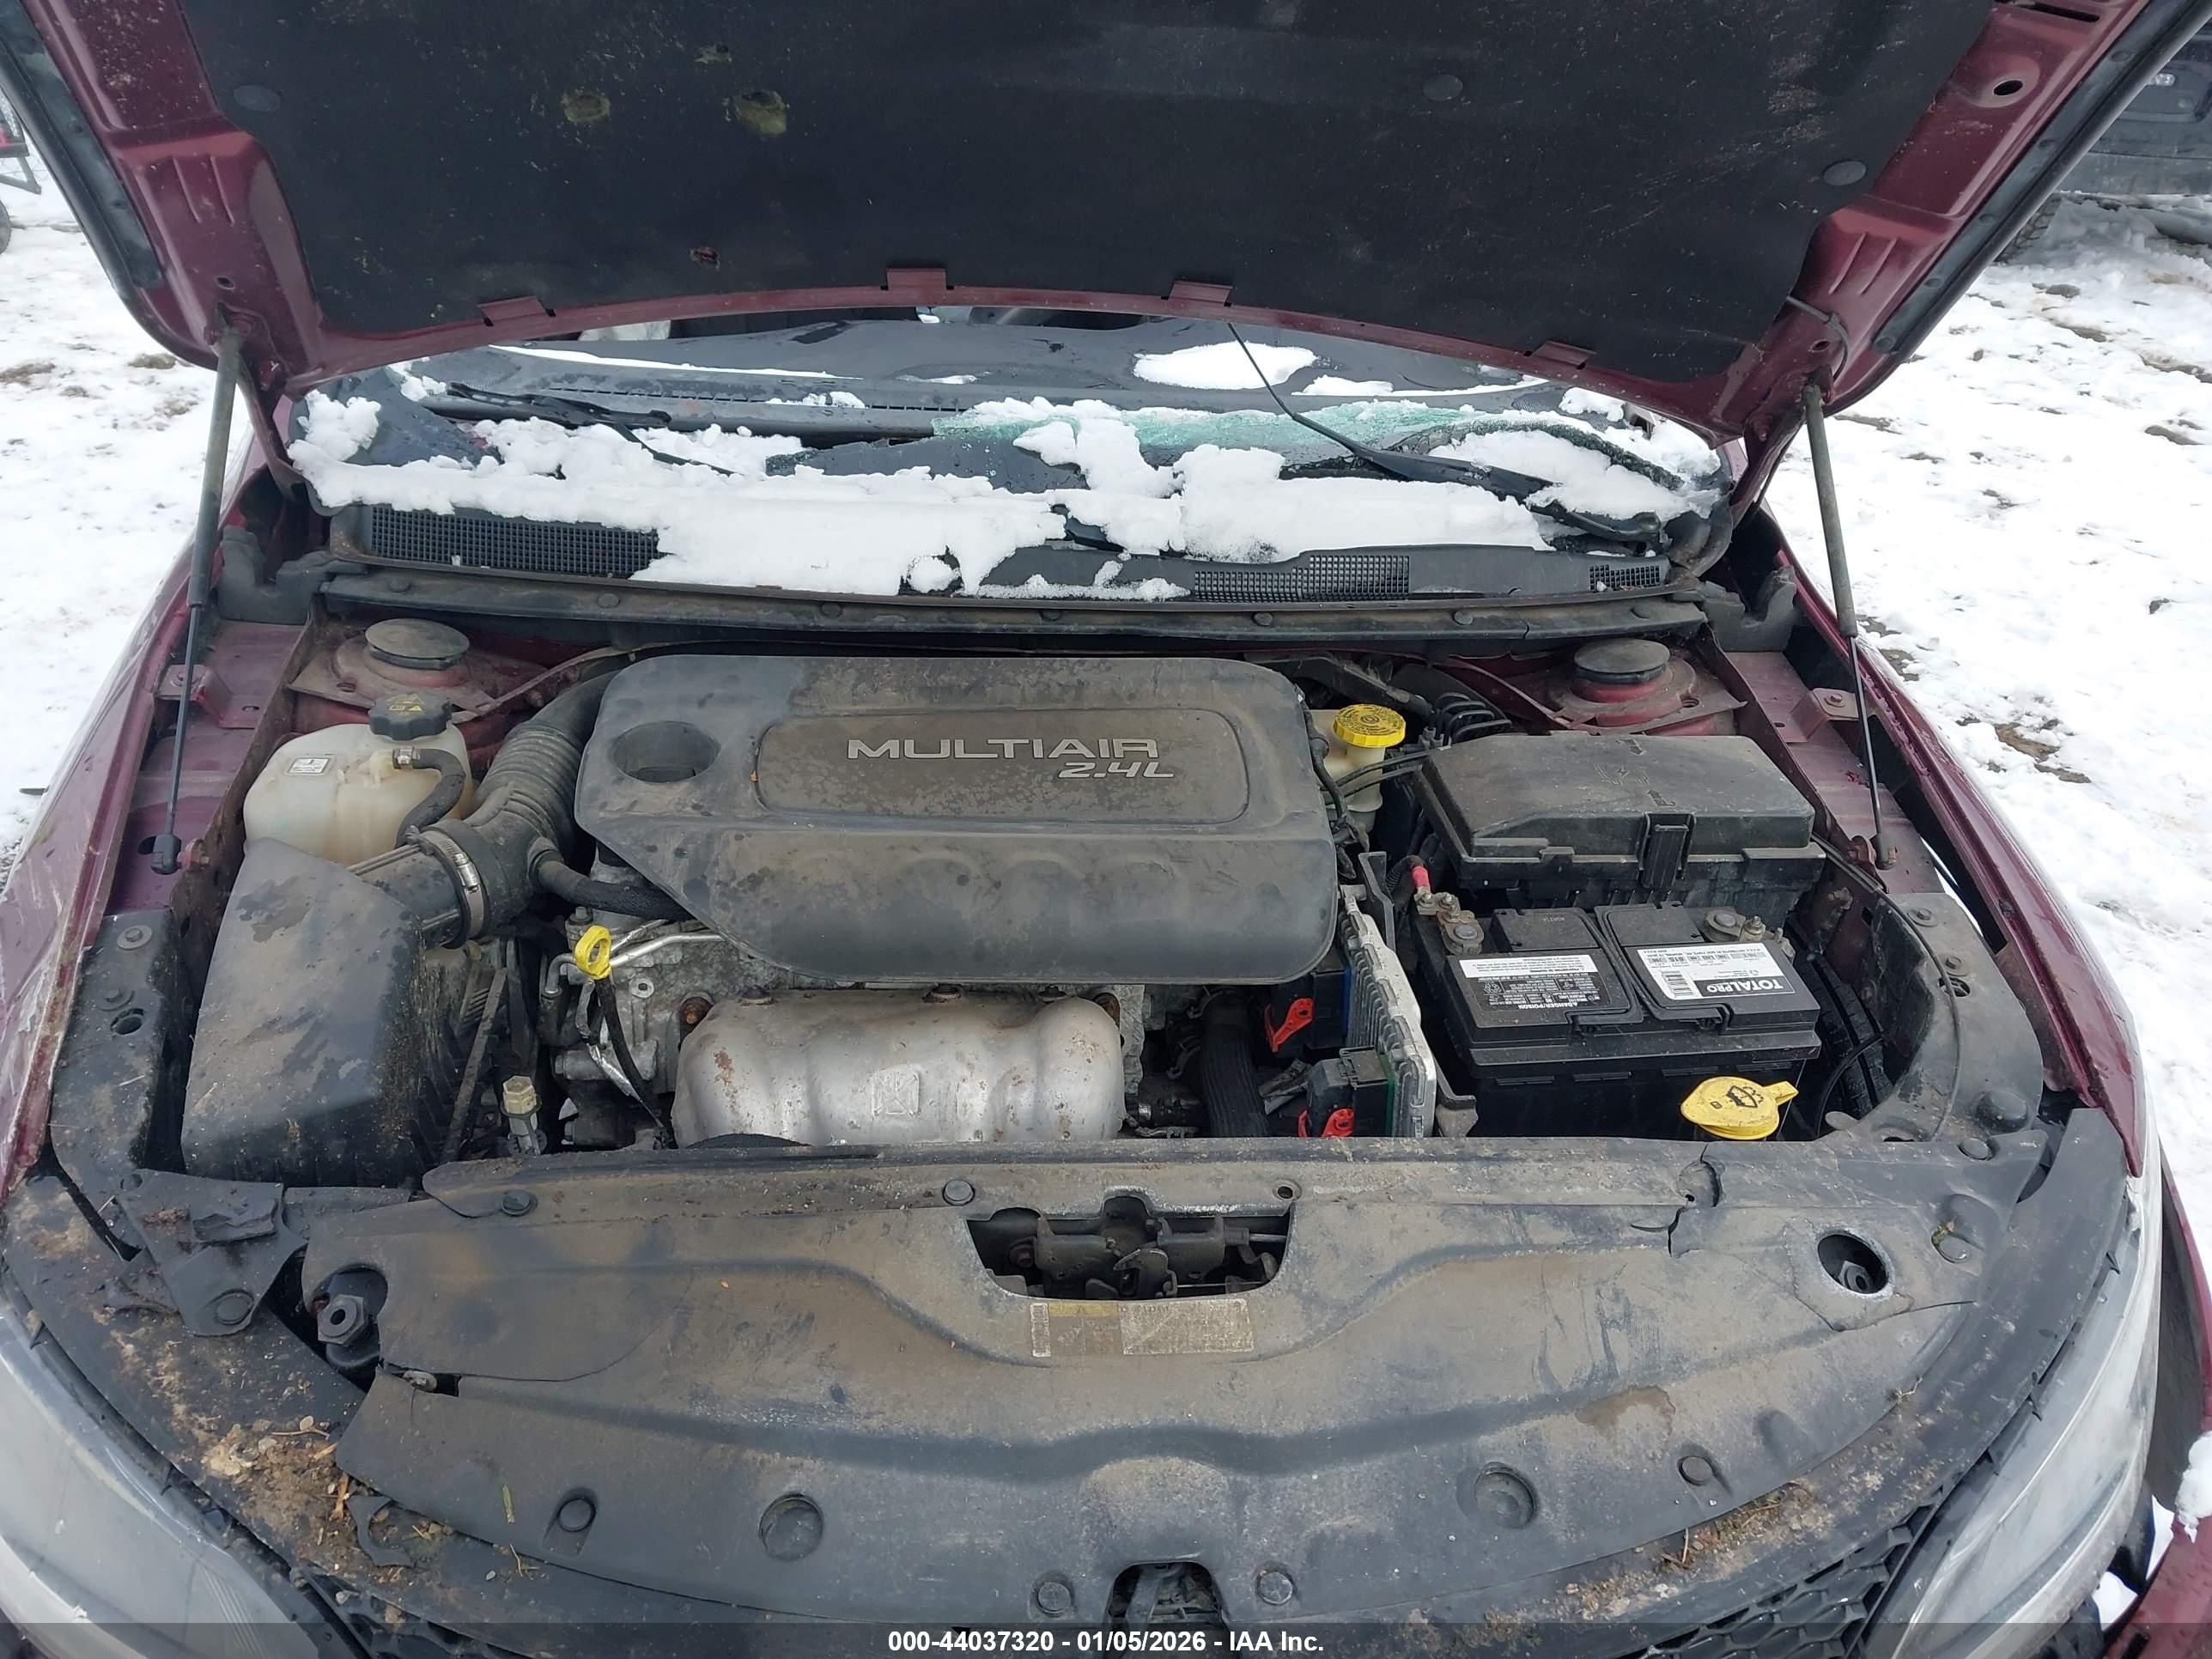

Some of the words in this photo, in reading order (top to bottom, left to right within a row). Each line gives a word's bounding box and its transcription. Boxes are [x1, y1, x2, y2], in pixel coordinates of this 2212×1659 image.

[847, 738, 1159, 759] MULTIAIR
[1058, 762, 1176, 779] 2.4L
[1706, 979, 1784, 994] TOTALPRO
